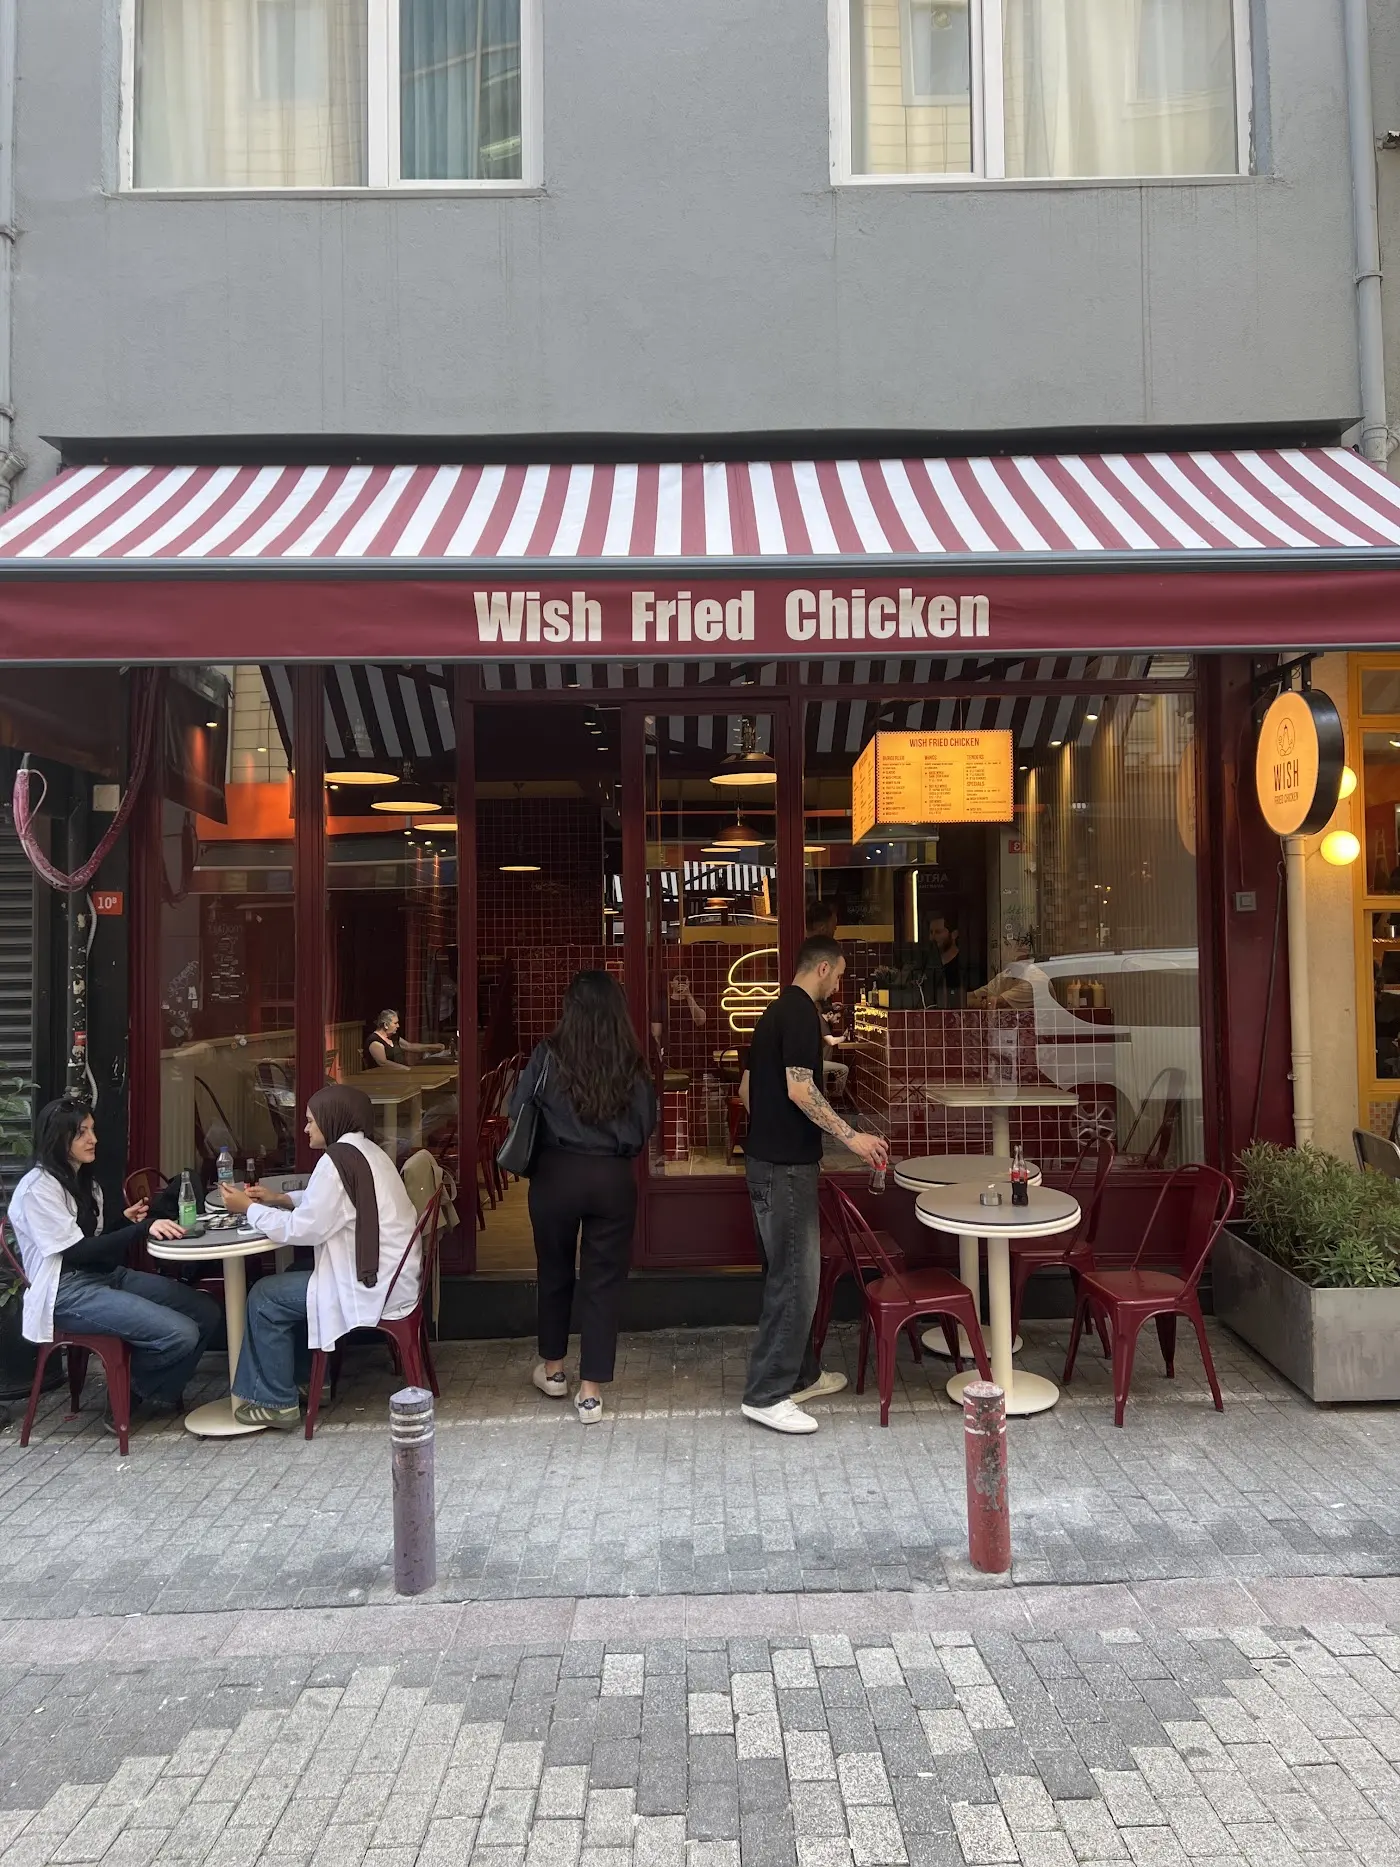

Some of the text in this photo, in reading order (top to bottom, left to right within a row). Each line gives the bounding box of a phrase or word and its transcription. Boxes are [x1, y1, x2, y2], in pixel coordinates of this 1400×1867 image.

[474, 588, 990, 642] Wish Fried Chicken
[909, 737, 980, 747] WISH FRIED CHICKEN
[1273, 759, 1299, 792] WISH
[1274, 792, 1299, 805] FRIED CHICKEN
